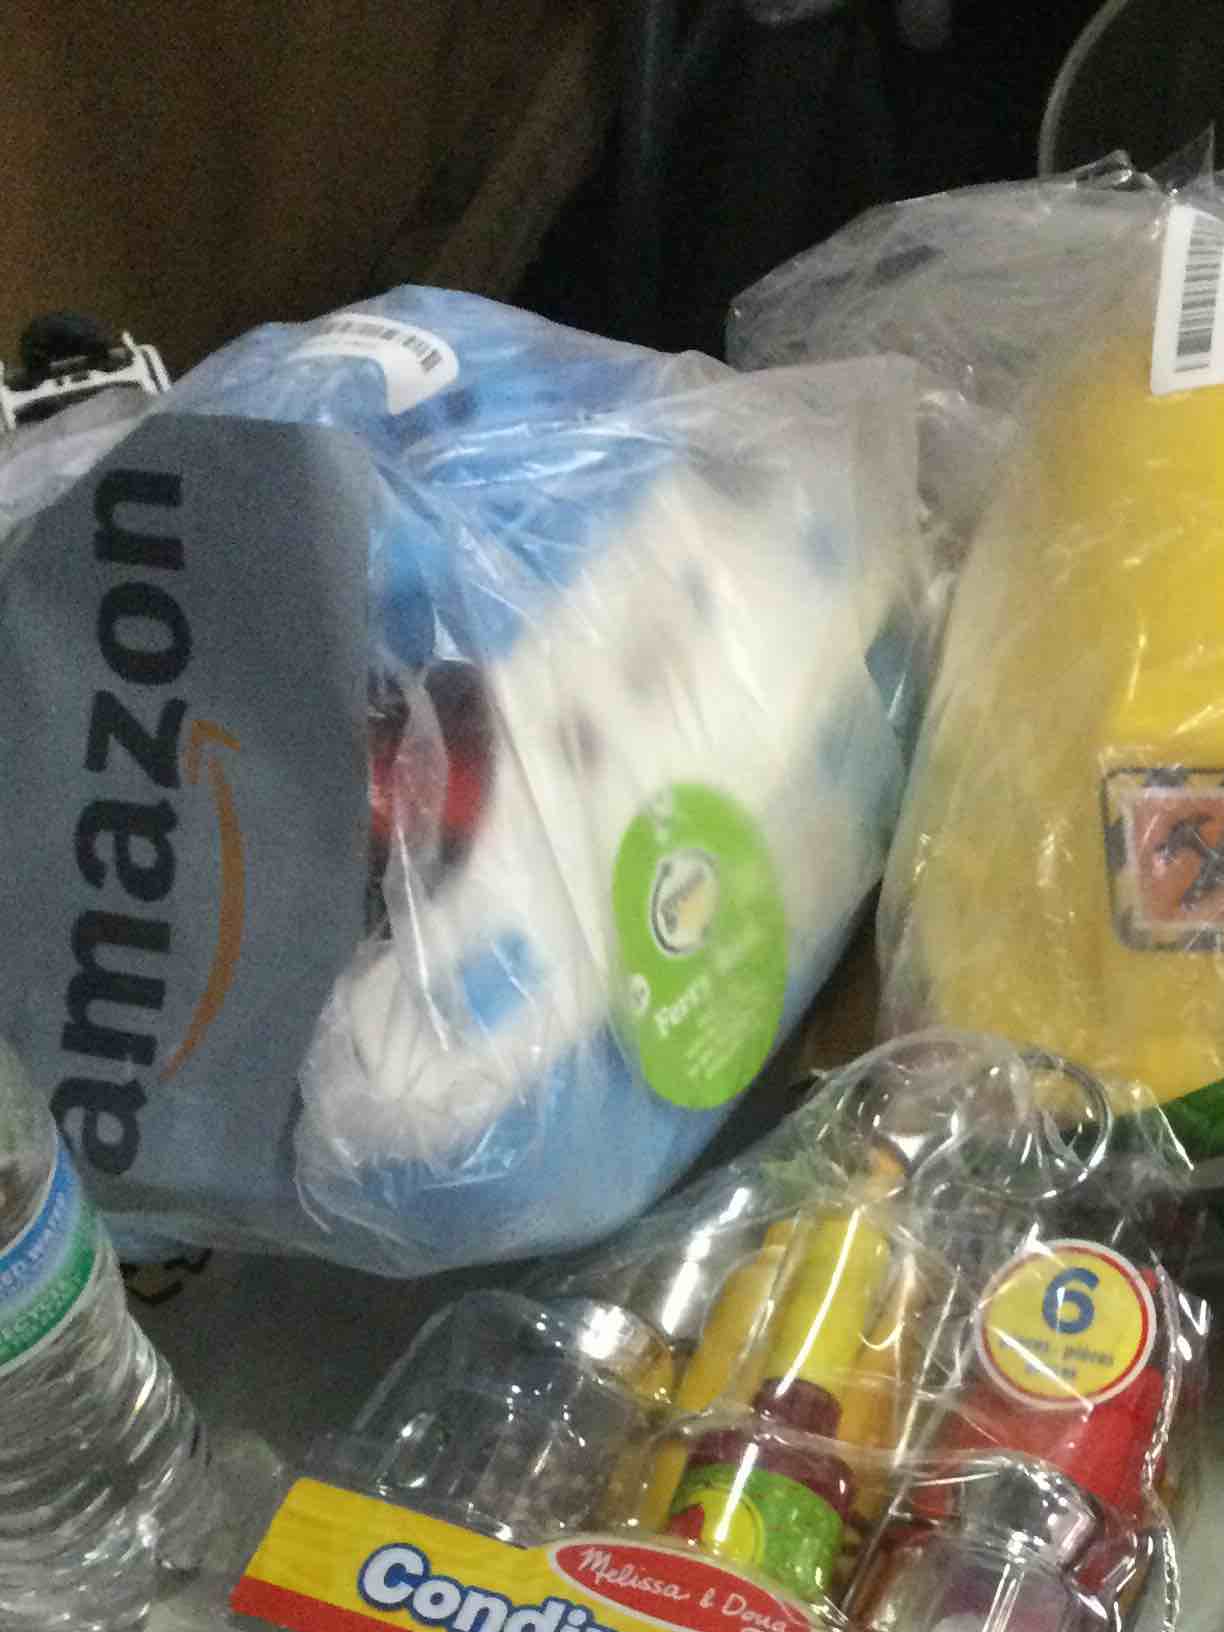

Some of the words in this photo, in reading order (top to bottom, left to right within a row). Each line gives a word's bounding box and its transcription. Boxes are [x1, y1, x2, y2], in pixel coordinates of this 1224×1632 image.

[50, 466, 193, 1176] amazon
[1042, 1268, 1099, 1335] 6
[578, 1547, 690, 1602] Melissa
[700, 1582, 713, 1609] &
